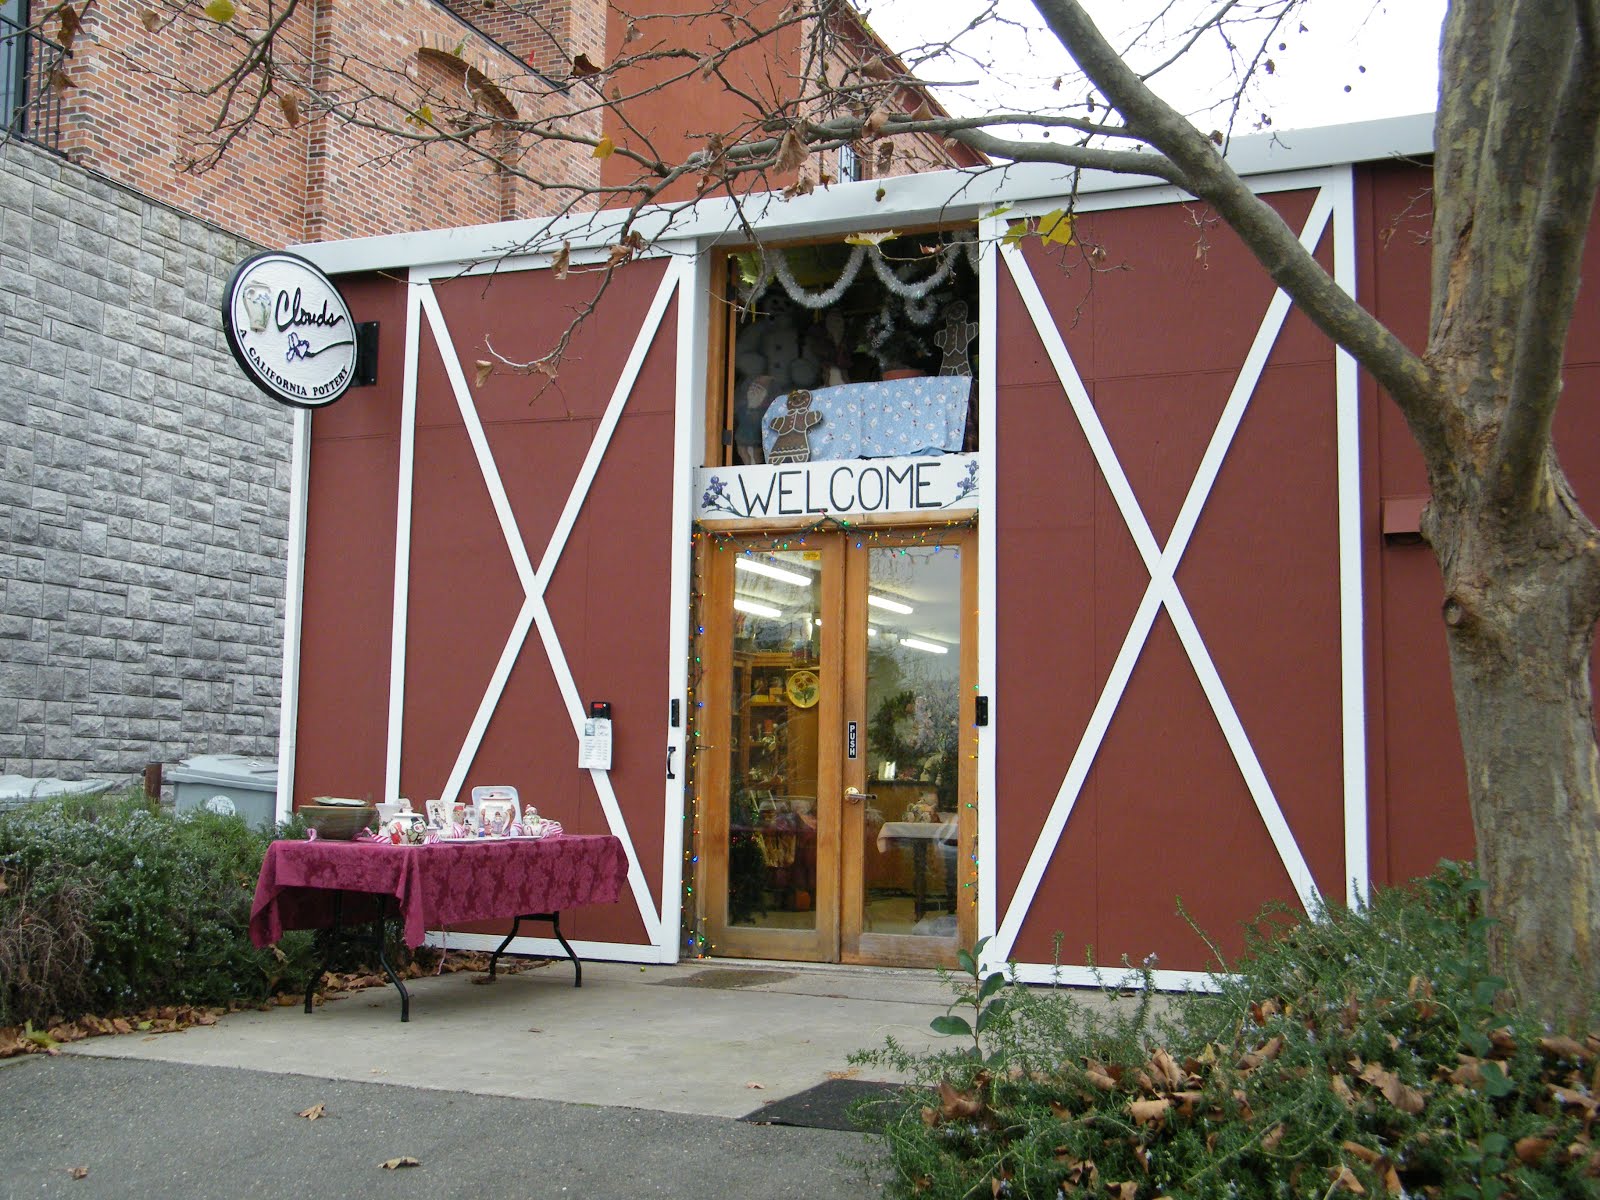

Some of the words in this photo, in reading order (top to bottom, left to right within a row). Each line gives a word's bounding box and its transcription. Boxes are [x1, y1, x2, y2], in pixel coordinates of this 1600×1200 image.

[275, 287, 345, 332] Clouds
[239, 328, 248, 338] A
[249, 347, 307, 396] CALIFORNIA
[313, 366, 348, 396] POTTERY
[738, 462, 942, 516] WELCOME
